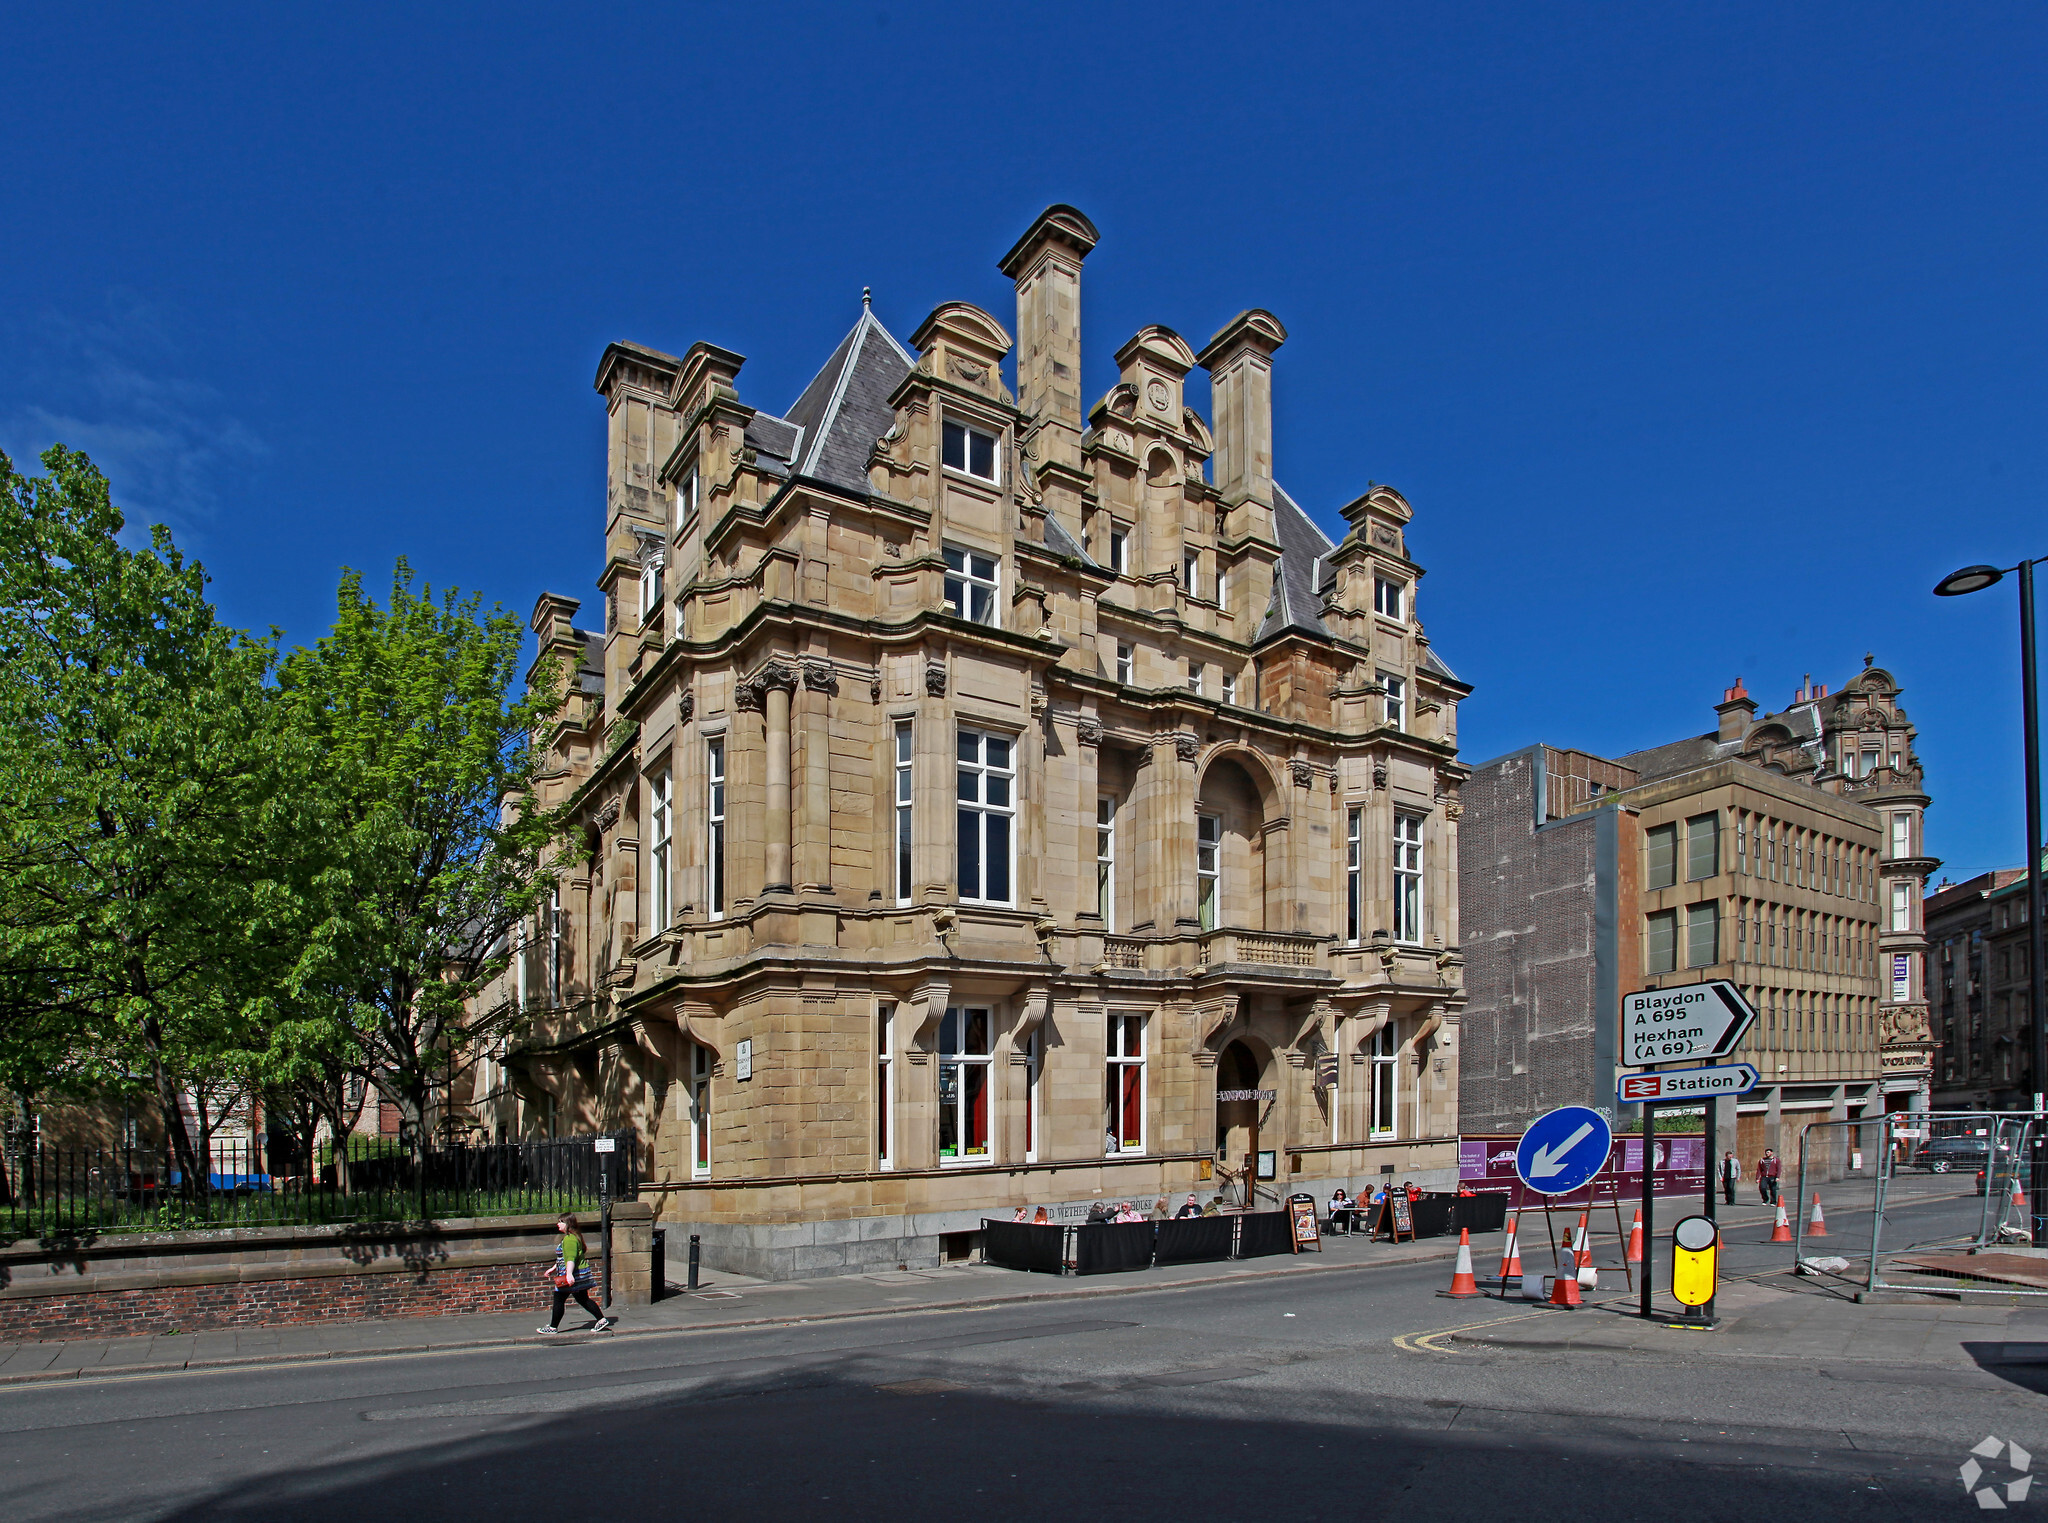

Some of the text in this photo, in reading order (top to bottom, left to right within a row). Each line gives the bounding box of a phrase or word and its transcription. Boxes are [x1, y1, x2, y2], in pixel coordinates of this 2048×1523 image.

[1634, 992, 1705, 1010] Blaydon
[1635, 1008, 1687, 1025] A 695
[1634, 1027, 1703, 1043] Hexham
[1634, 1045, 1656, 1059] (A
[1661, 1040, 1693, 1055] 69)
[1666, 1076, 1733, 1091] Station
